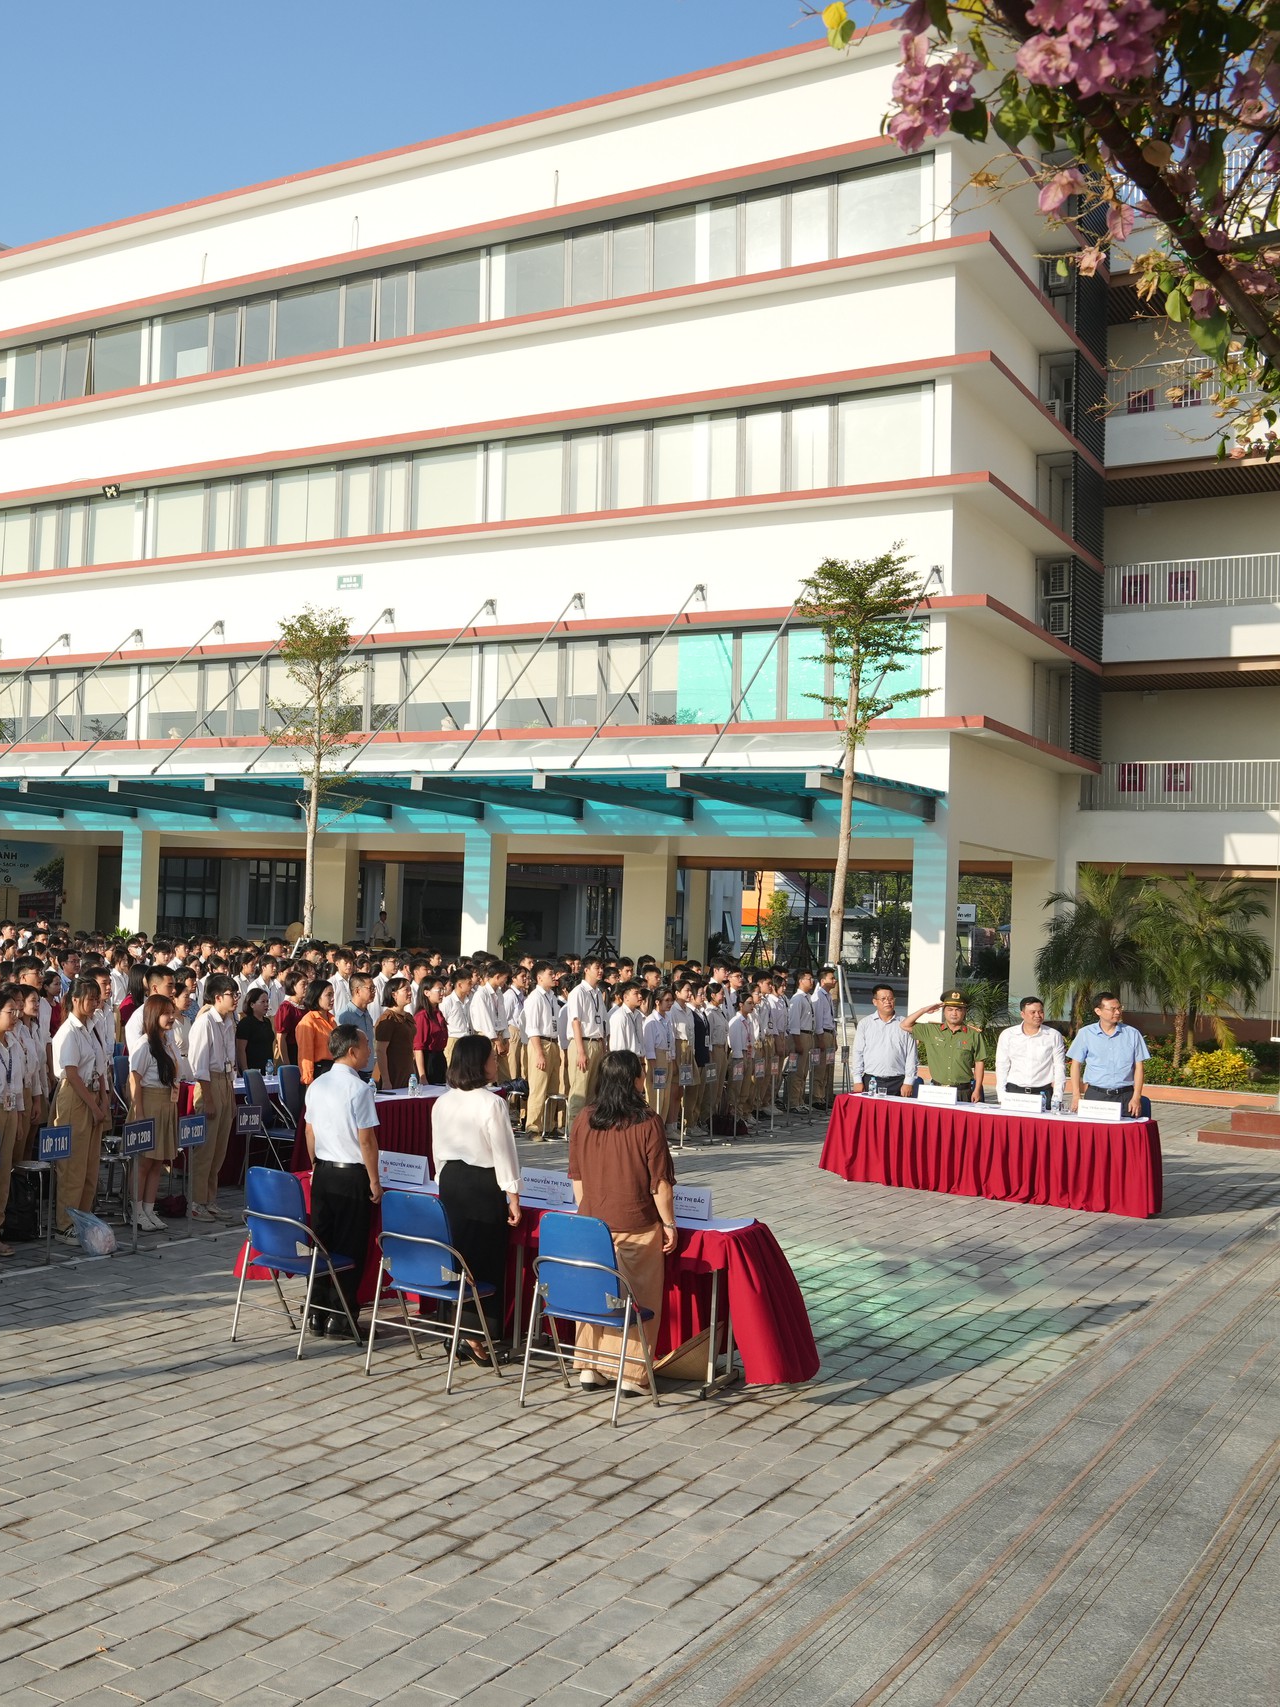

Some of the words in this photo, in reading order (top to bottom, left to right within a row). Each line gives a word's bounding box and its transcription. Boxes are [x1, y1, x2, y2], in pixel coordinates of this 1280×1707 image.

[240, 1113, 249, 1126] LỚP
[127, 1131, 137, 1146] LỚP
[138, 1130, 151, 1144] 12D8
[181, 1125, 190, 1140] LỚP
[191, 1125, 204, 1138] 12D7
[42, 1135, 54, 1153] LỚP
[54, 1136, 68, 1152] 11A1
